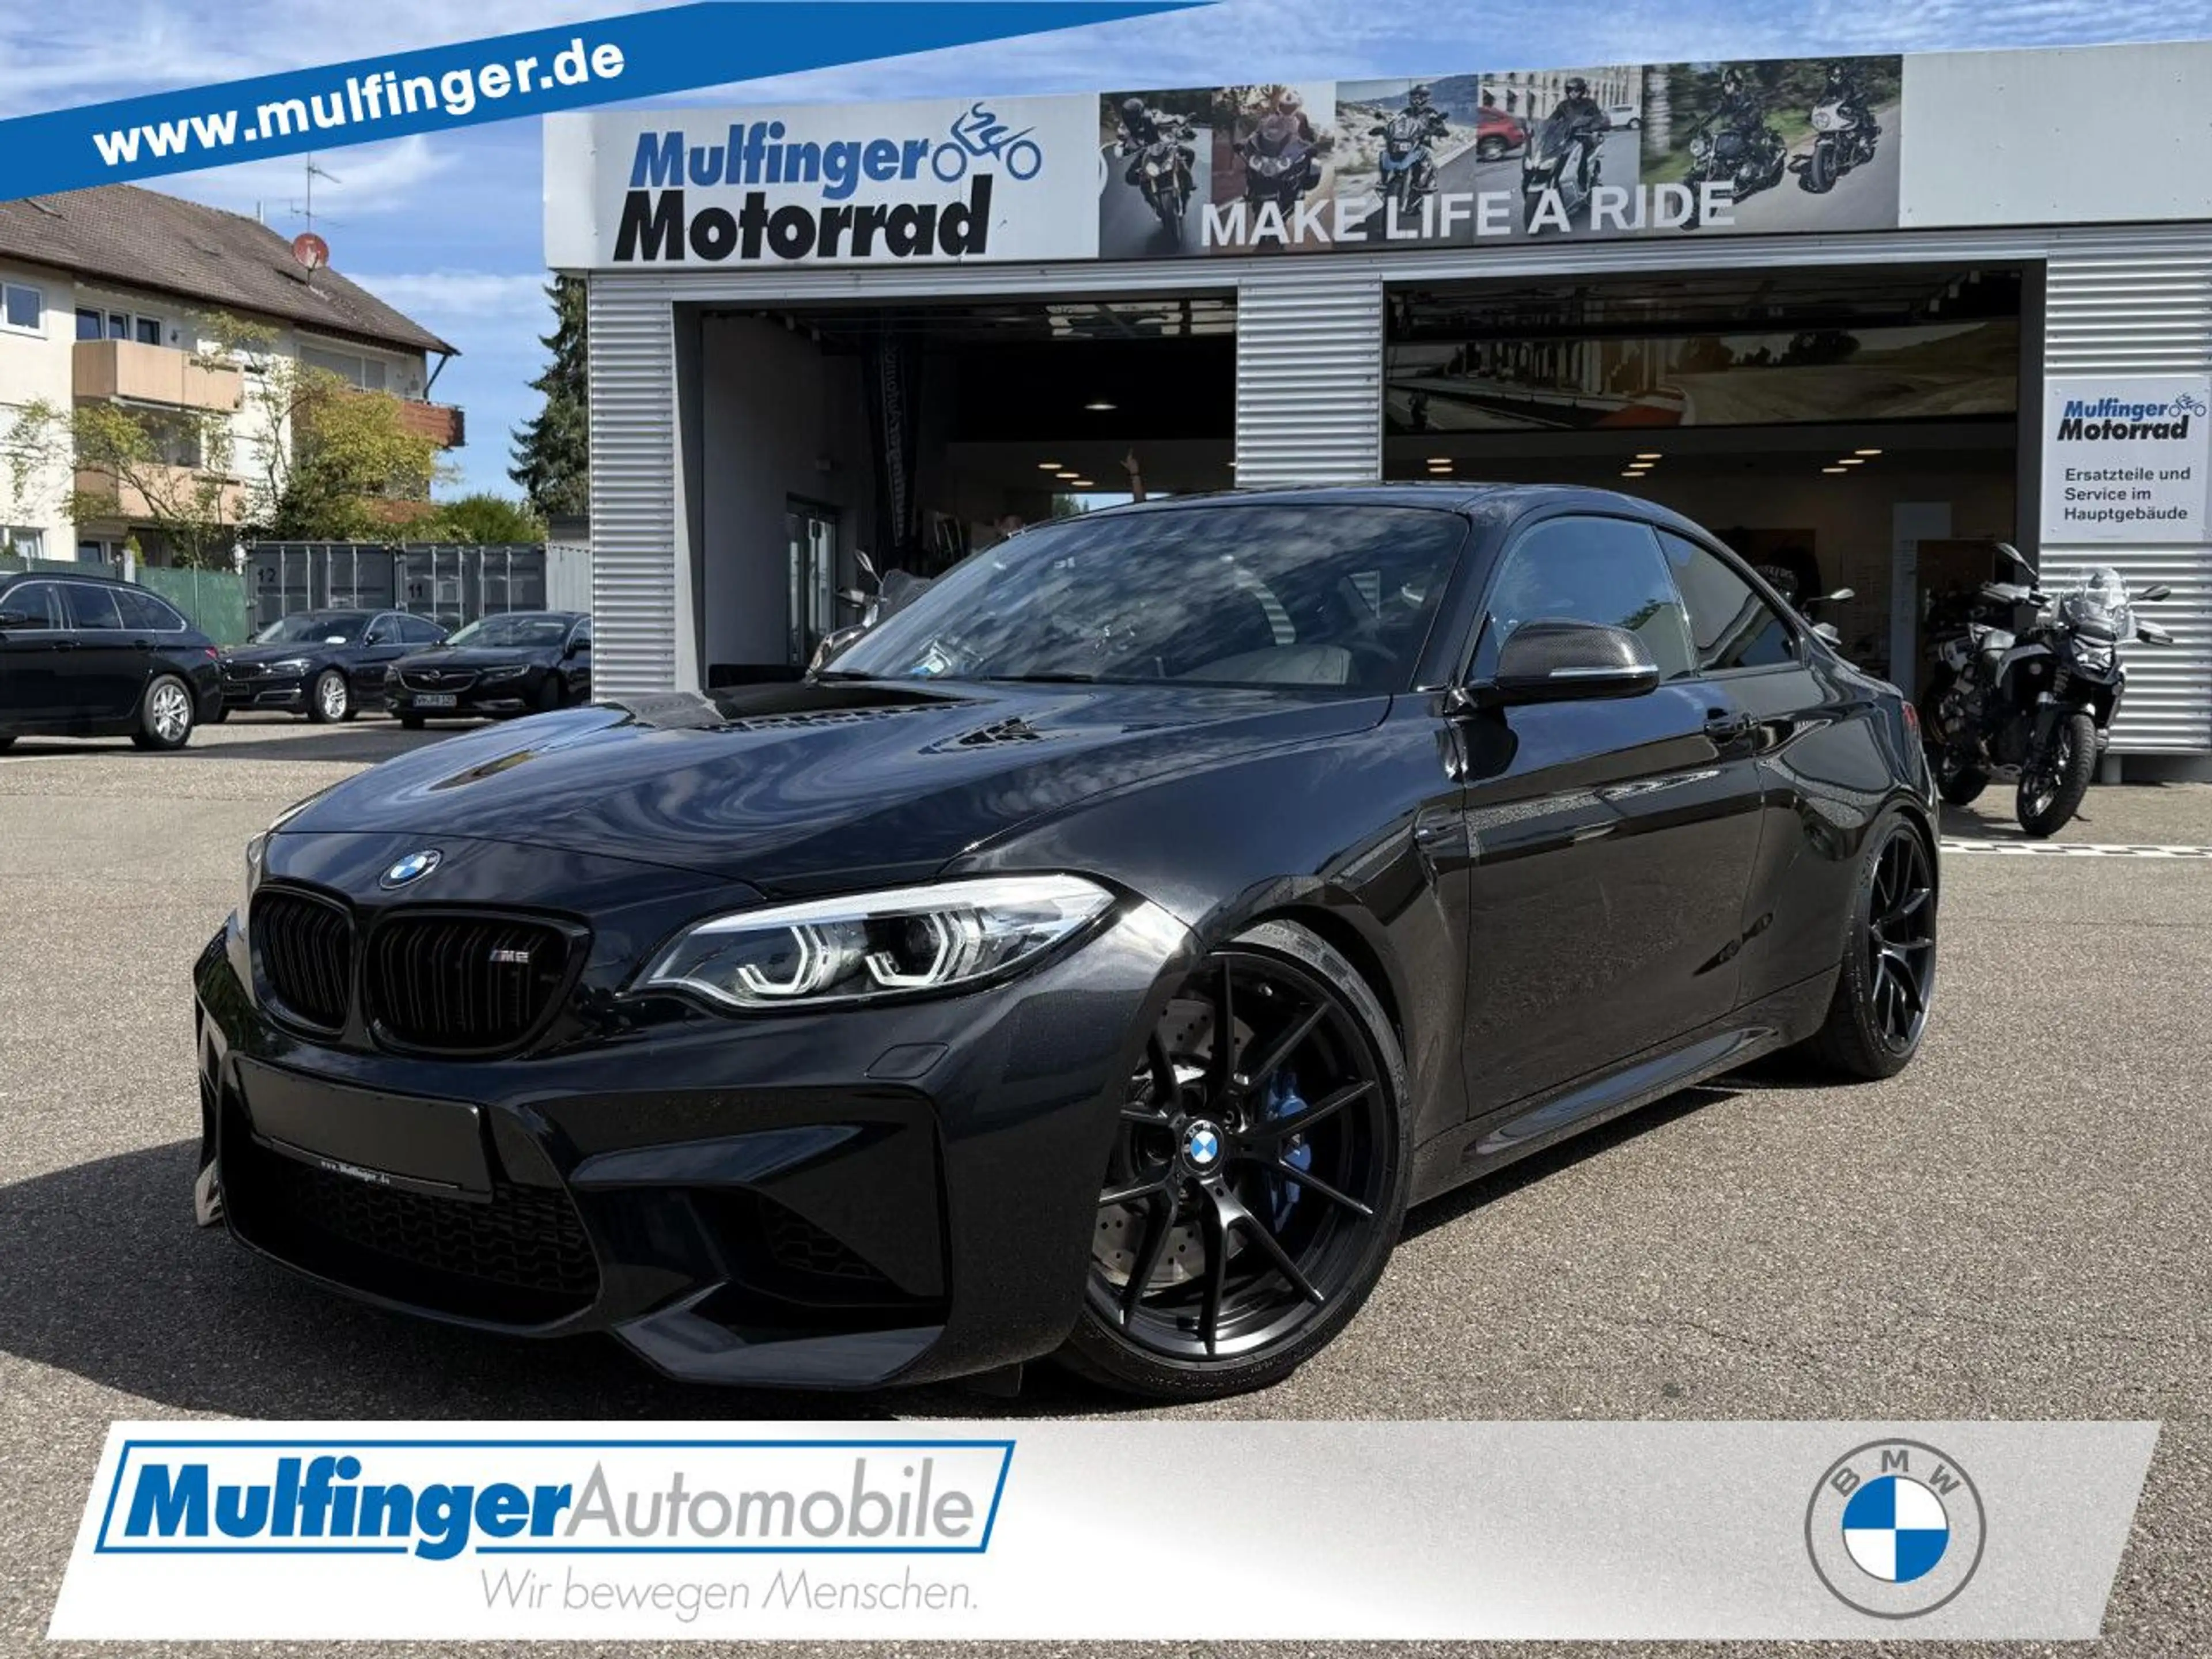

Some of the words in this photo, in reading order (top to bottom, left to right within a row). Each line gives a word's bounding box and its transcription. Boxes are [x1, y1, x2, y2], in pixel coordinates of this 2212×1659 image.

[630, 121, 929, 200] Mulfinger
[613, 173, 993, 262] Motorrad
[1202, 196, 1368, 247] MAKE
[1385, 192, 1512, 240] LIFE
[1527, 188, 1571, 235] A
[1590, 181, 1736, 232] RIDE
[2063, 397, 2168, 422] Mulfinger
[2056, 415, 2190, 441] Motorrad
[2065, 467, 2154, 482] Ersatzteile
[2159, 467, 2191, 480] und
[2065, 487, 2127, 501] Service
[2132, 487, 2151, 501] im
[2065, 506, 2188, 522] Hauptgebäude
[257, 566, 276, 583] 12
